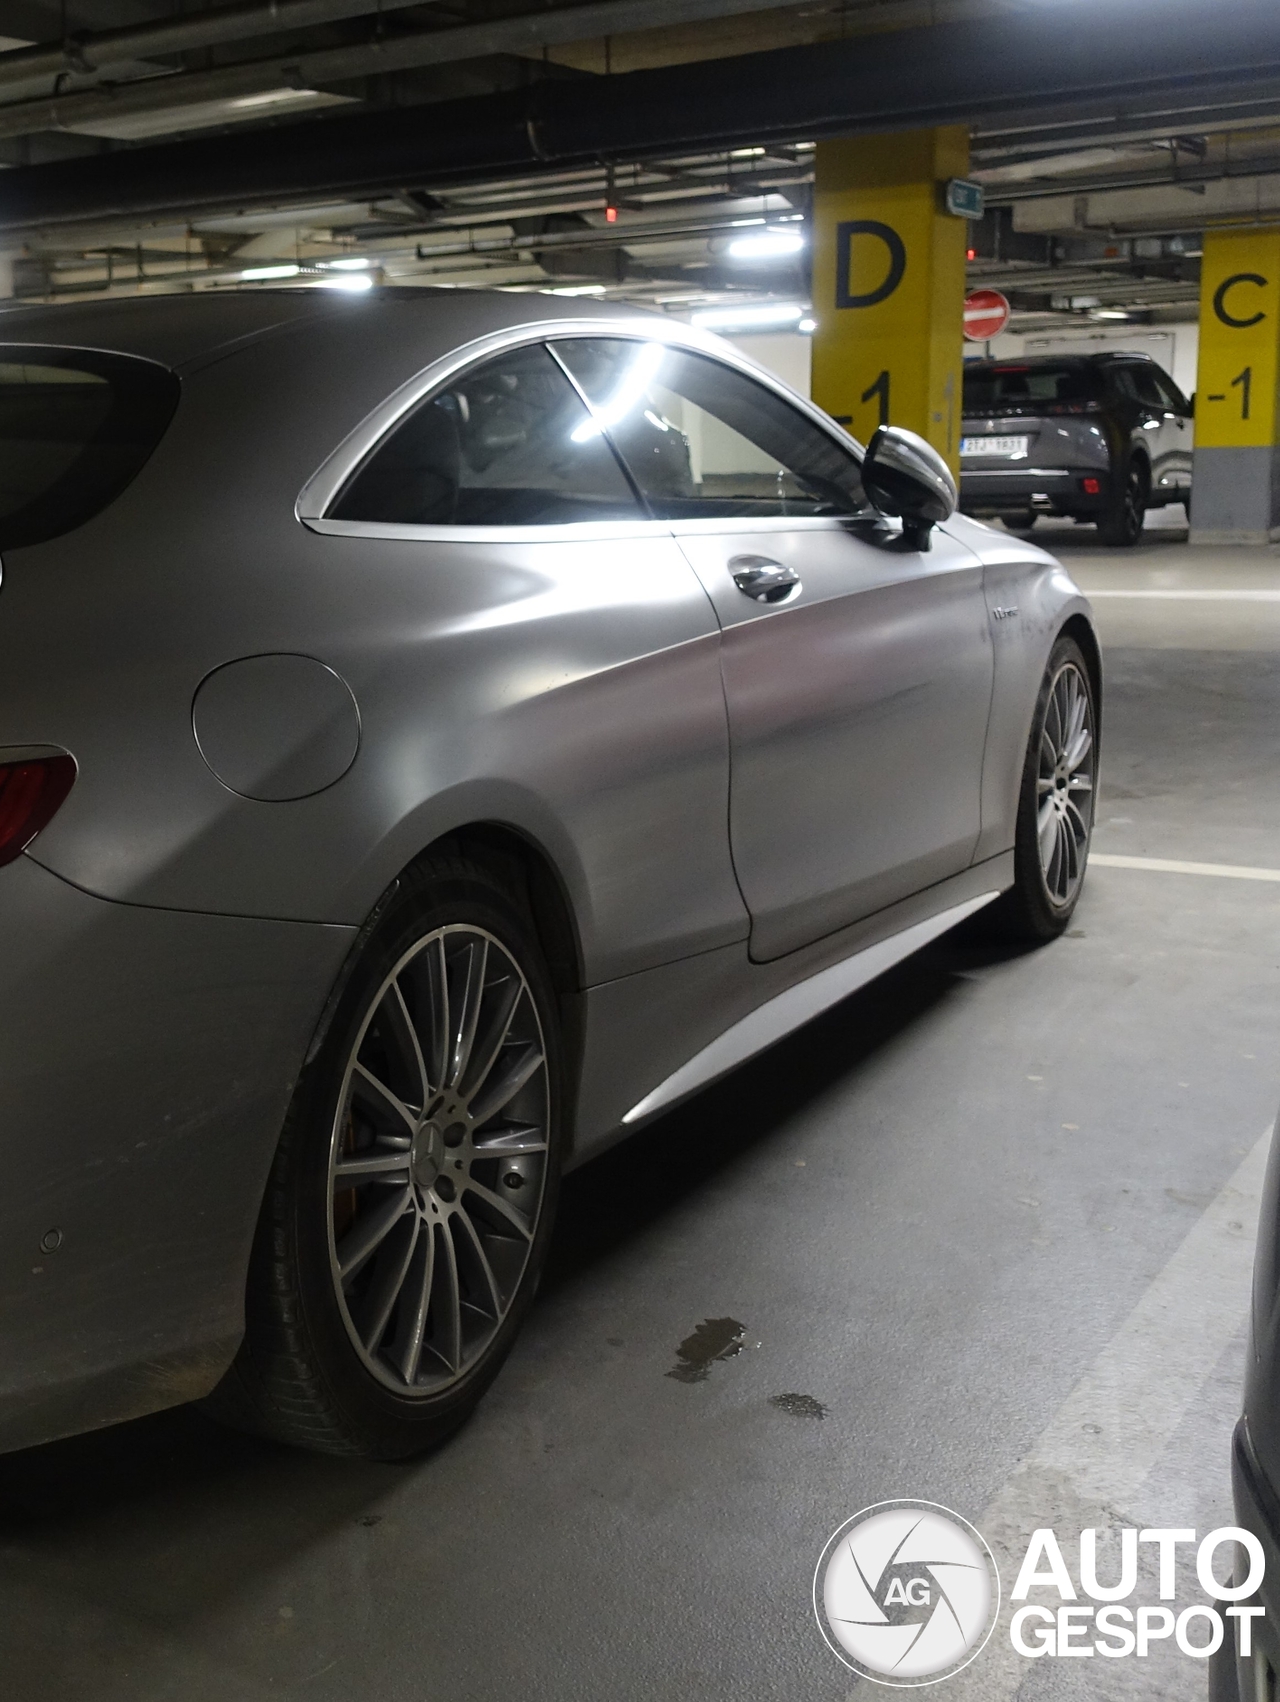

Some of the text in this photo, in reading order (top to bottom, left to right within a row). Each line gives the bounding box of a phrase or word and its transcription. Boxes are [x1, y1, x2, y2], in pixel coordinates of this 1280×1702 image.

[835, 220, 906, 309] D
[1213, 273, 1269, 328] C
[1207, 366, 1252, 420] -1
